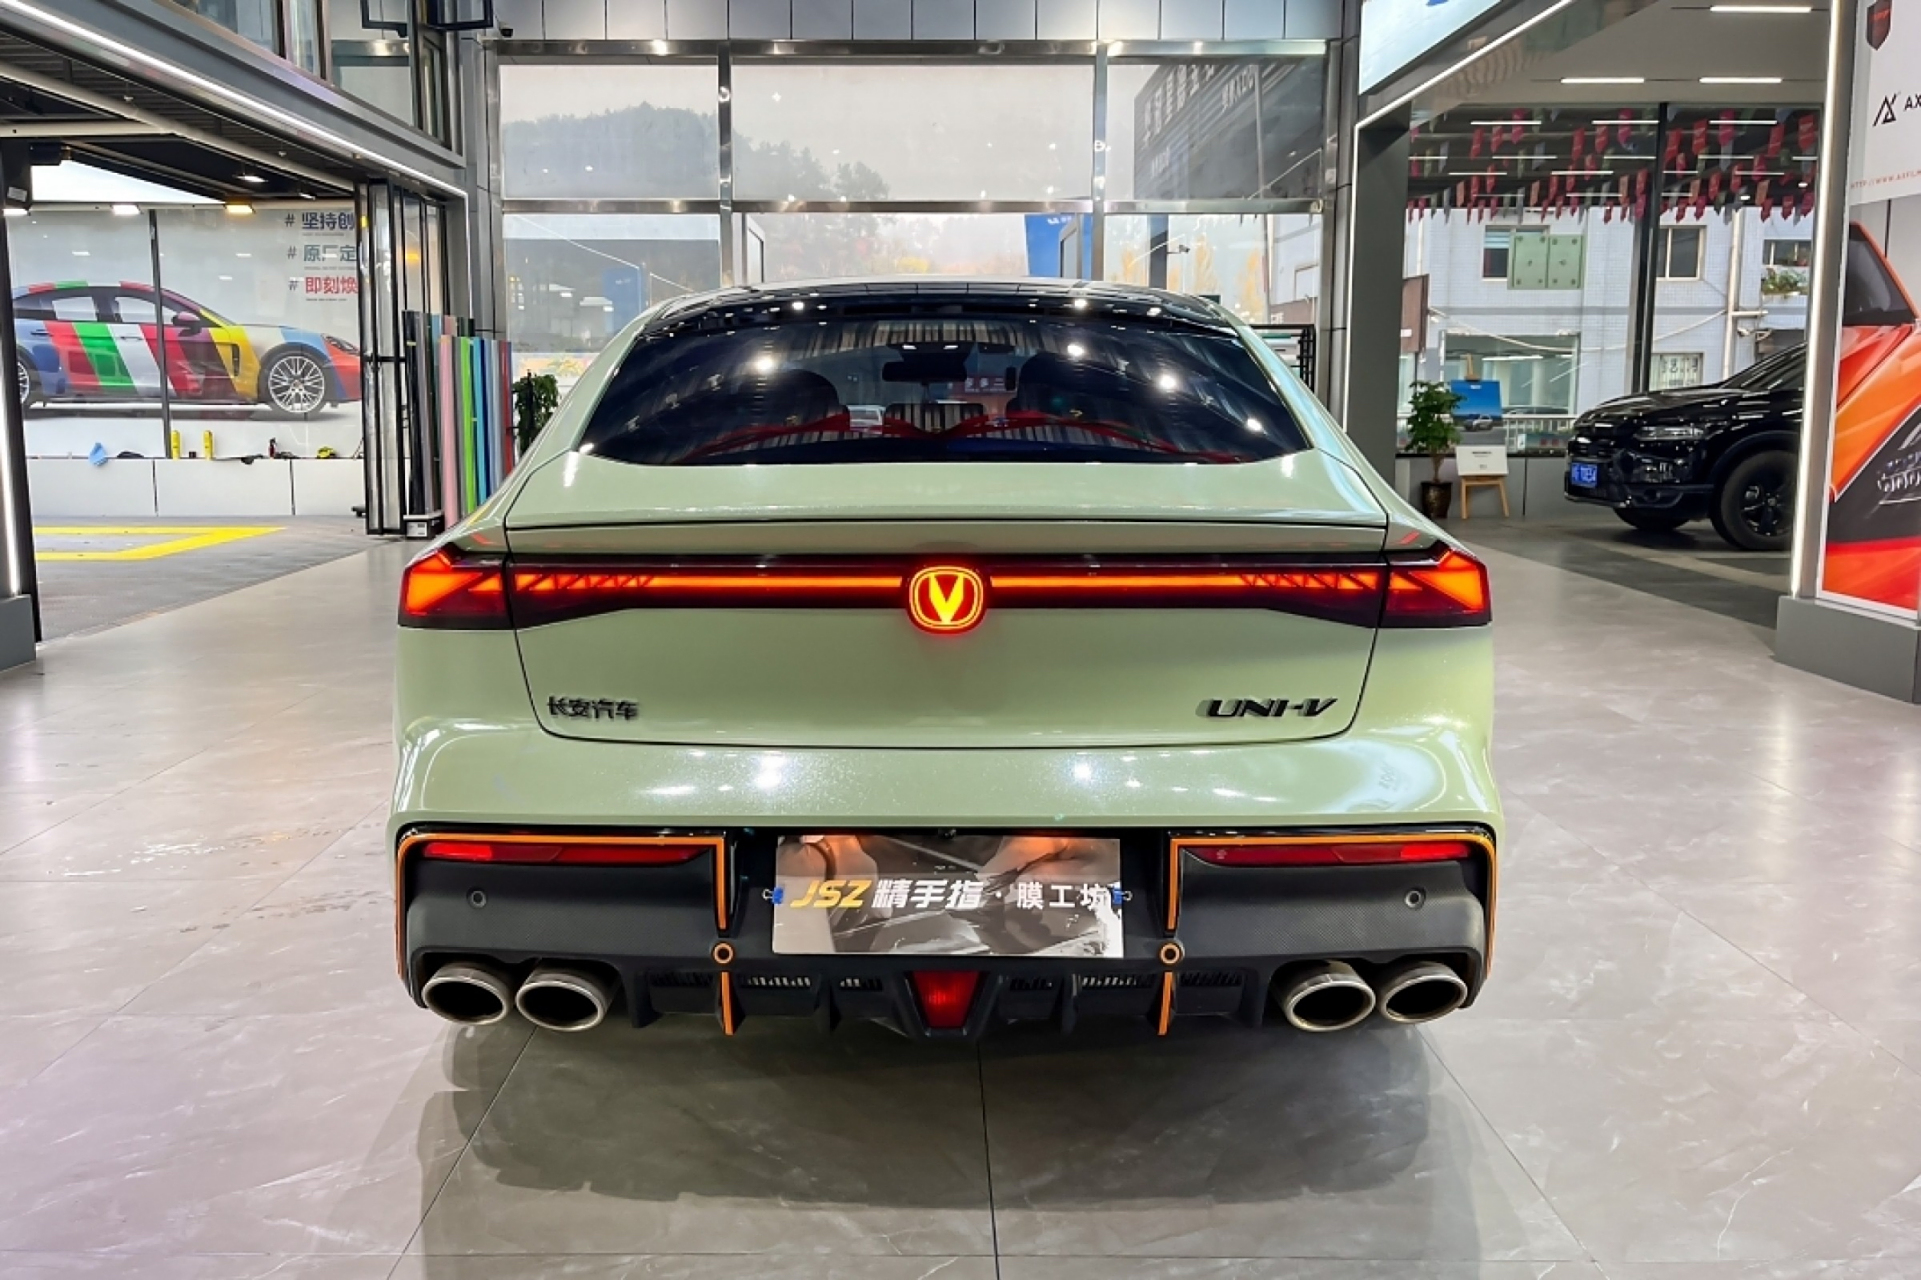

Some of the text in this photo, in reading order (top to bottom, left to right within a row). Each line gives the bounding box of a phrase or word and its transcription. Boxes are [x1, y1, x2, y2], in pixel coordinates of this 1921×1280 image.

[547, 696, 638, 720] 长安汽车
[1197, 698, 1338, 717] UNI-V
[790, 879, 872, 909] JSZ
